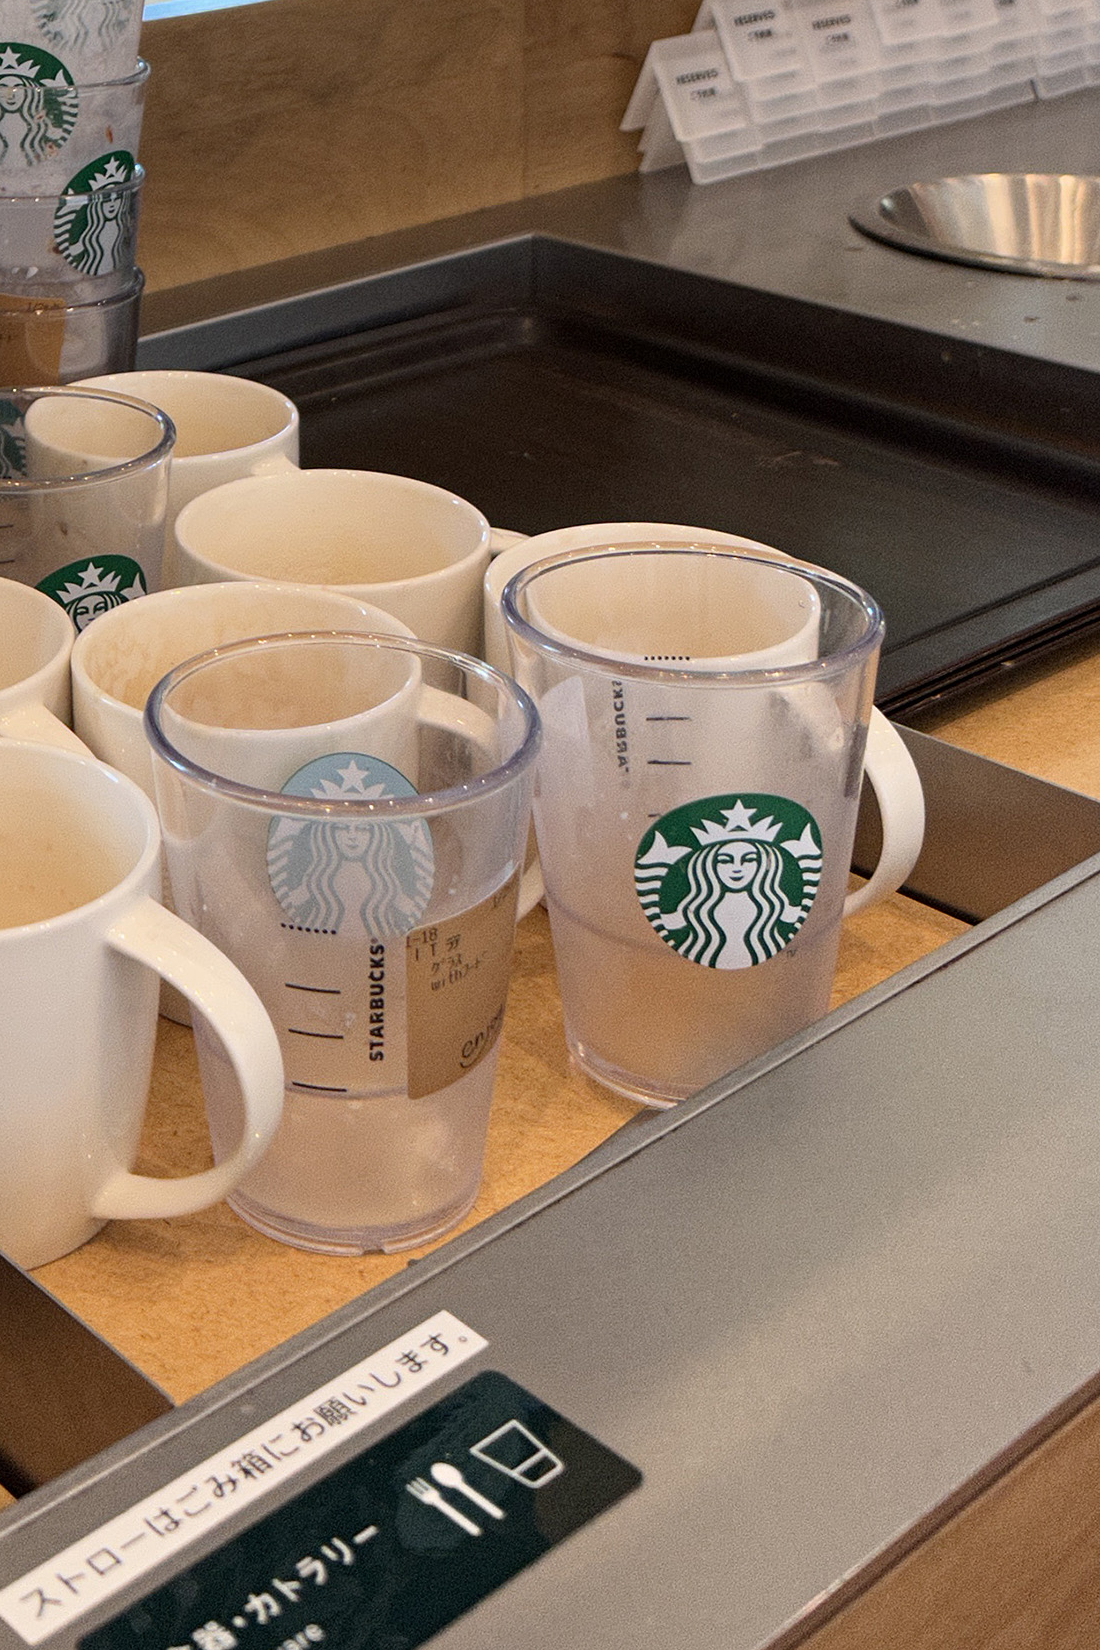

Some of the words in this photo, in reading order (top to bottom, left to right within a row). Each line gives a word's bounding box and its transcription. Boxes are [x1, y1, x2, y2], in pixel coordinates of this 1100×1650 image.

[19, 1330, 470, 1618] ストローはごみ箱にお願いします。
[165, 1524, 380, 1650] 器・カトラリー
